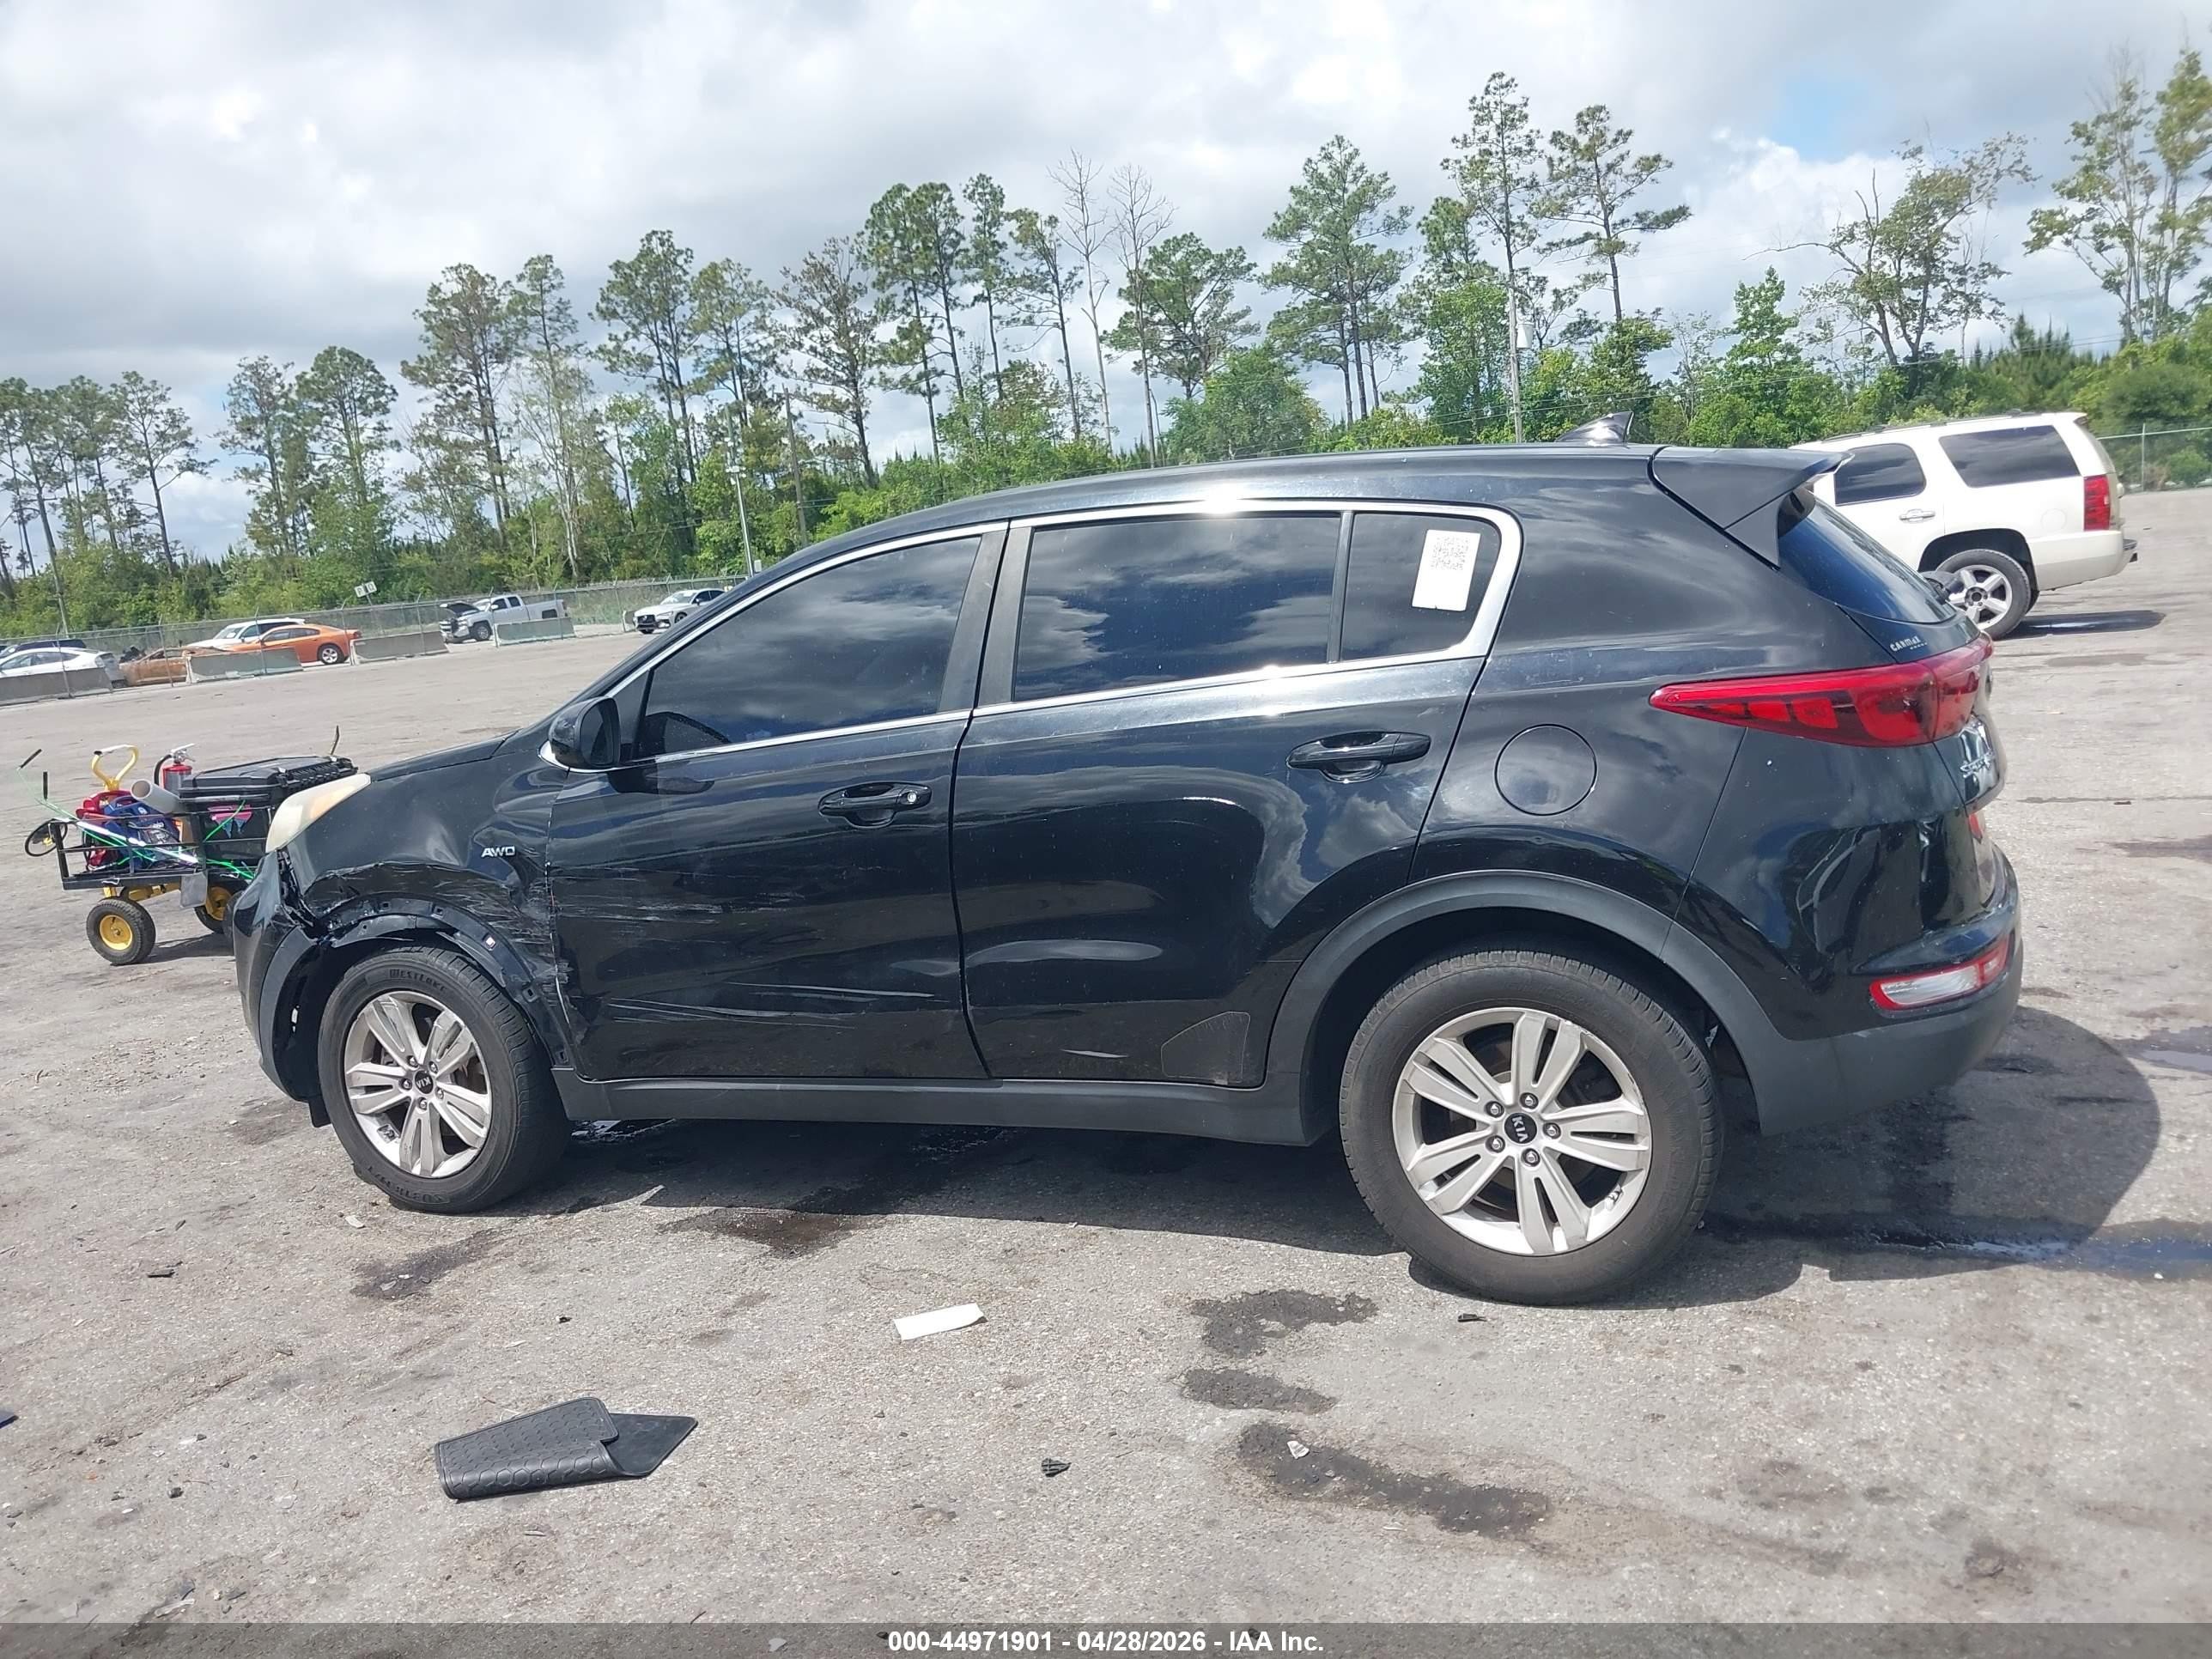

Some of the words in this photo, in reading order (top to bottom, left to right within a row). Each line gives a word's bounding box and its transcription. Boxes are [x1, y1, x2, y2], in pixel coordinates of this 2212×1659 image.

[481, 846, 515, 858] AWD
[416, 1076, 432, 1089] KIA
[1511, 1116, 1528, 1142] KIA
